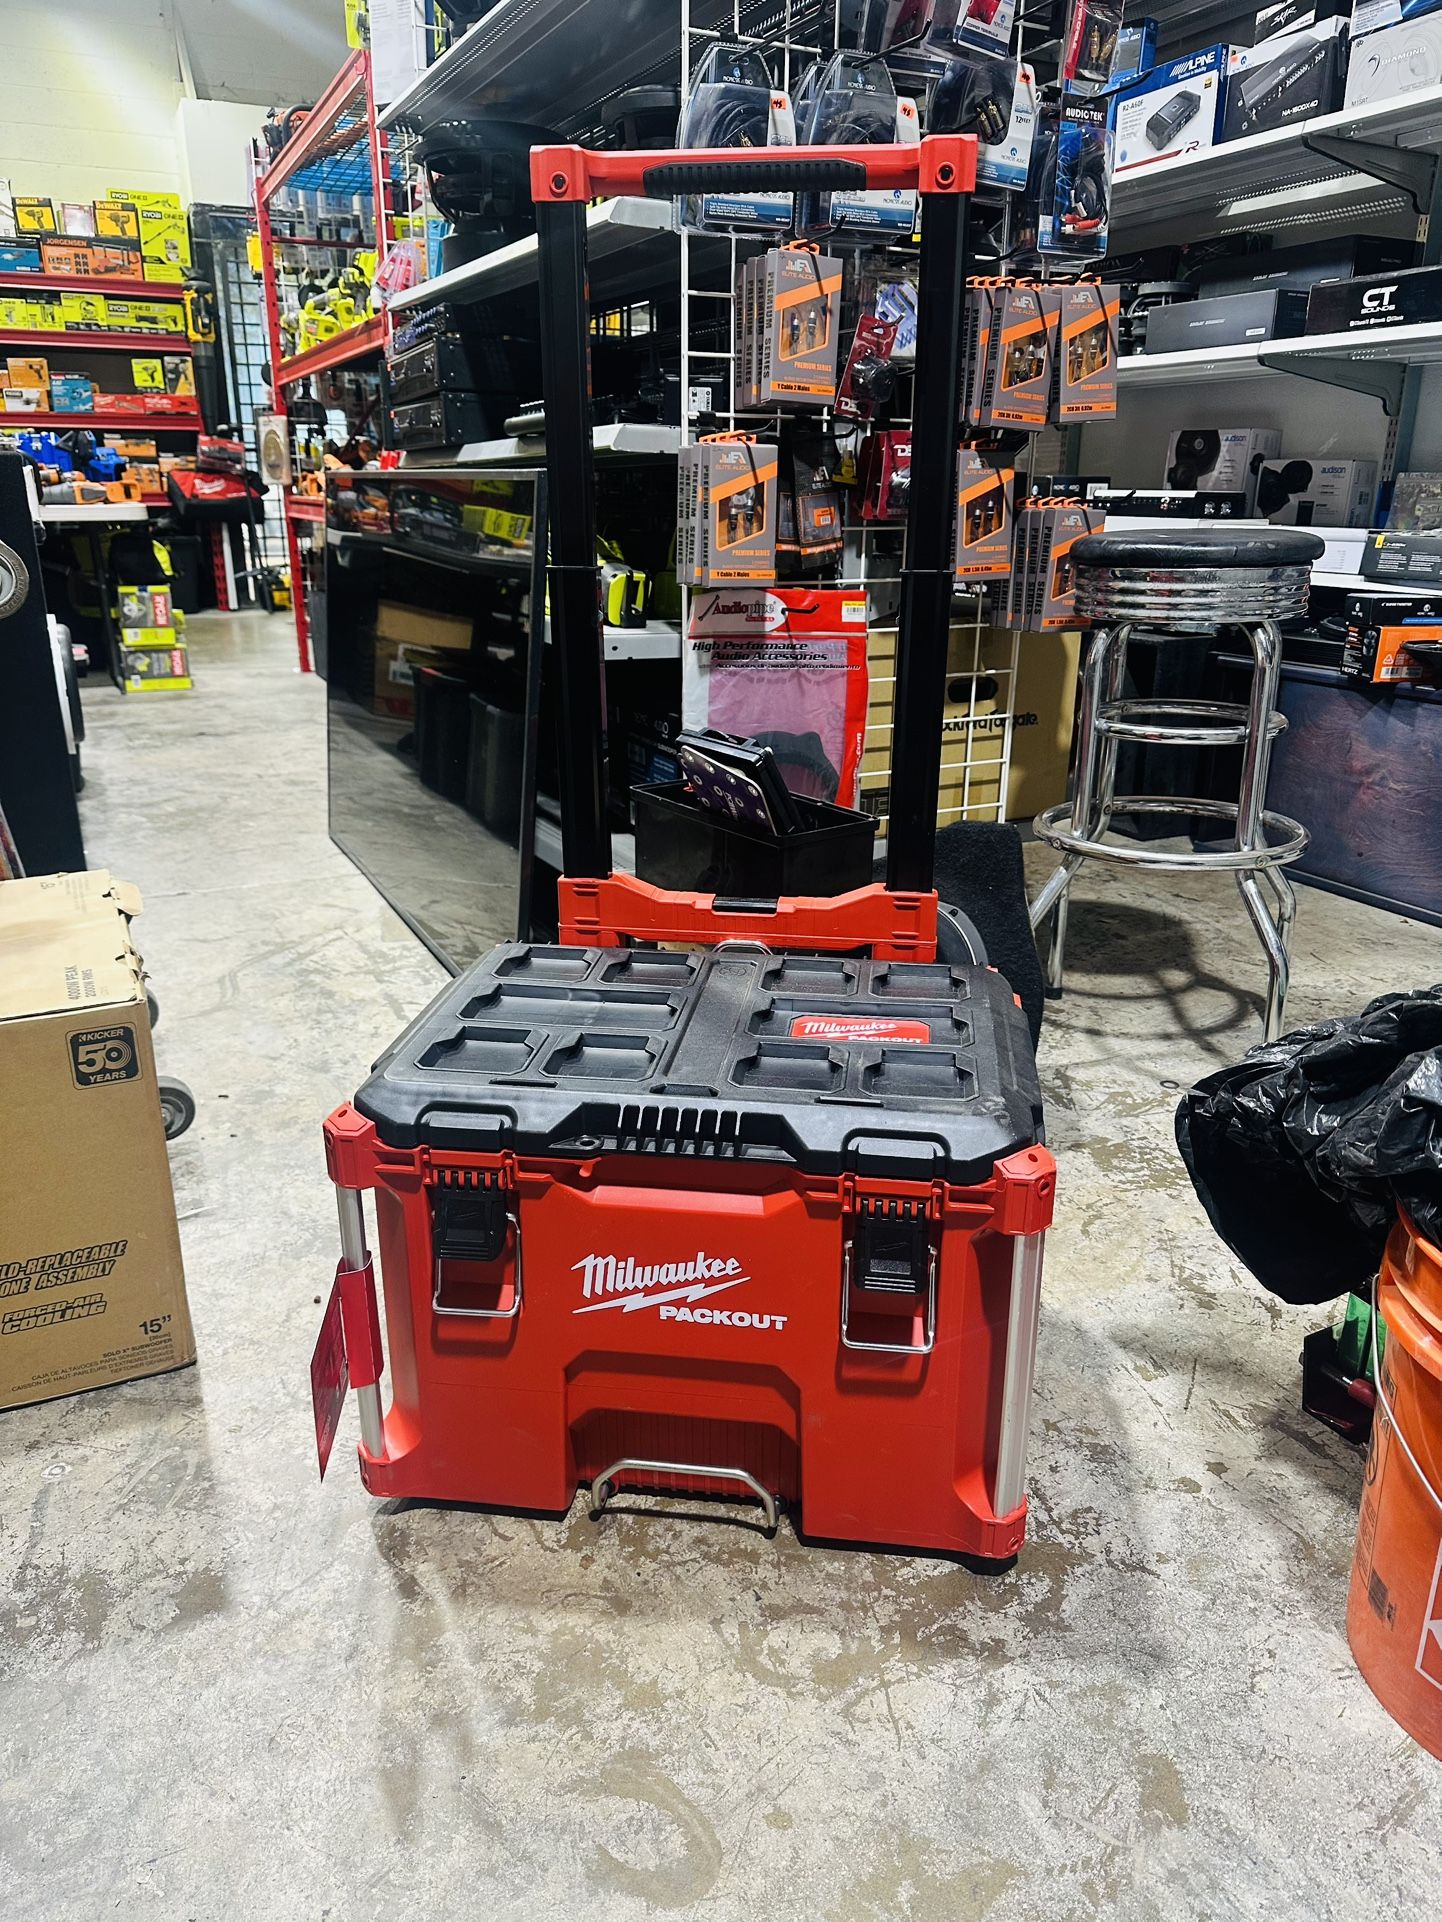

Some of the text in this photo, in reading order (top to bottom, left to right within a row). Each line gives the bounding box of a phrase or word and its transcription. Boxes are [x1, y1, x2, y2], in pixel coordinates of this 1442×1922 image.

[1169, 51, 1215, 78] ALPINE
[1381, 46, 1426, 66] DIAMOND
[1065, 107, 1103, 121] AUDIOTEK
[46, 238, 87, 247] JORGENSEN
[1363, 286, 1399, 308] CT
[1360, 304, 1396, 315] SOUNDS
[763, 271, 775, 379] PREMIUM SERIES
[983, 306, 1003, 408] PREMIUM SERIES
[1321, 465, 1346, 474] audison
[690, 463, 699, 518] PREMIUM
[1034, 526, 1052, 615] PREMIUM SERIES
[712, 601, 775, 617] Audiopipe
[692, 640, 808, 653] High Performance
[711, 651, 828, 661] Audio Accessories
[1341, 666, 1358, 675] HERTZ
[65, 965, 80, 1000] 4000W PEAK
[87, 1028, 124, 1041] KICKER
[799, 1020, 898, 1034] Milwaukee
[847, 1034, 924, 1044] PACKOUT
[78, 1040, 132, 1073] 50
[89, 1070, 127, 1083] YEARS
[0, 1240, 128, 1281] LD-REPLACEABLE
[0, 1259, 116, 1298] ONE ASSEMBLY
[570, 1251, 743, 1299] Milwaukee
[2, 1301, 107, 1335] COOLING
[3, 1293, 103, 1323] FORCED-AIR
[659, 1305, 788, 1331] PACKOUT
[103, 1350, 121, 1358] SOLO
[131, 1337, 173, 1351] SUBWOOFER
[32, 1373, 49, 1381] CAJA
[50, 1369, 60, 1377] DE
[60, 1360, 99, 1374] ALTAVOCES
[99, 1356, 118, 1365] PARA
[11, 1380, 42, 1392] CAISSON
[43, 1377, 53, 1385] DE
